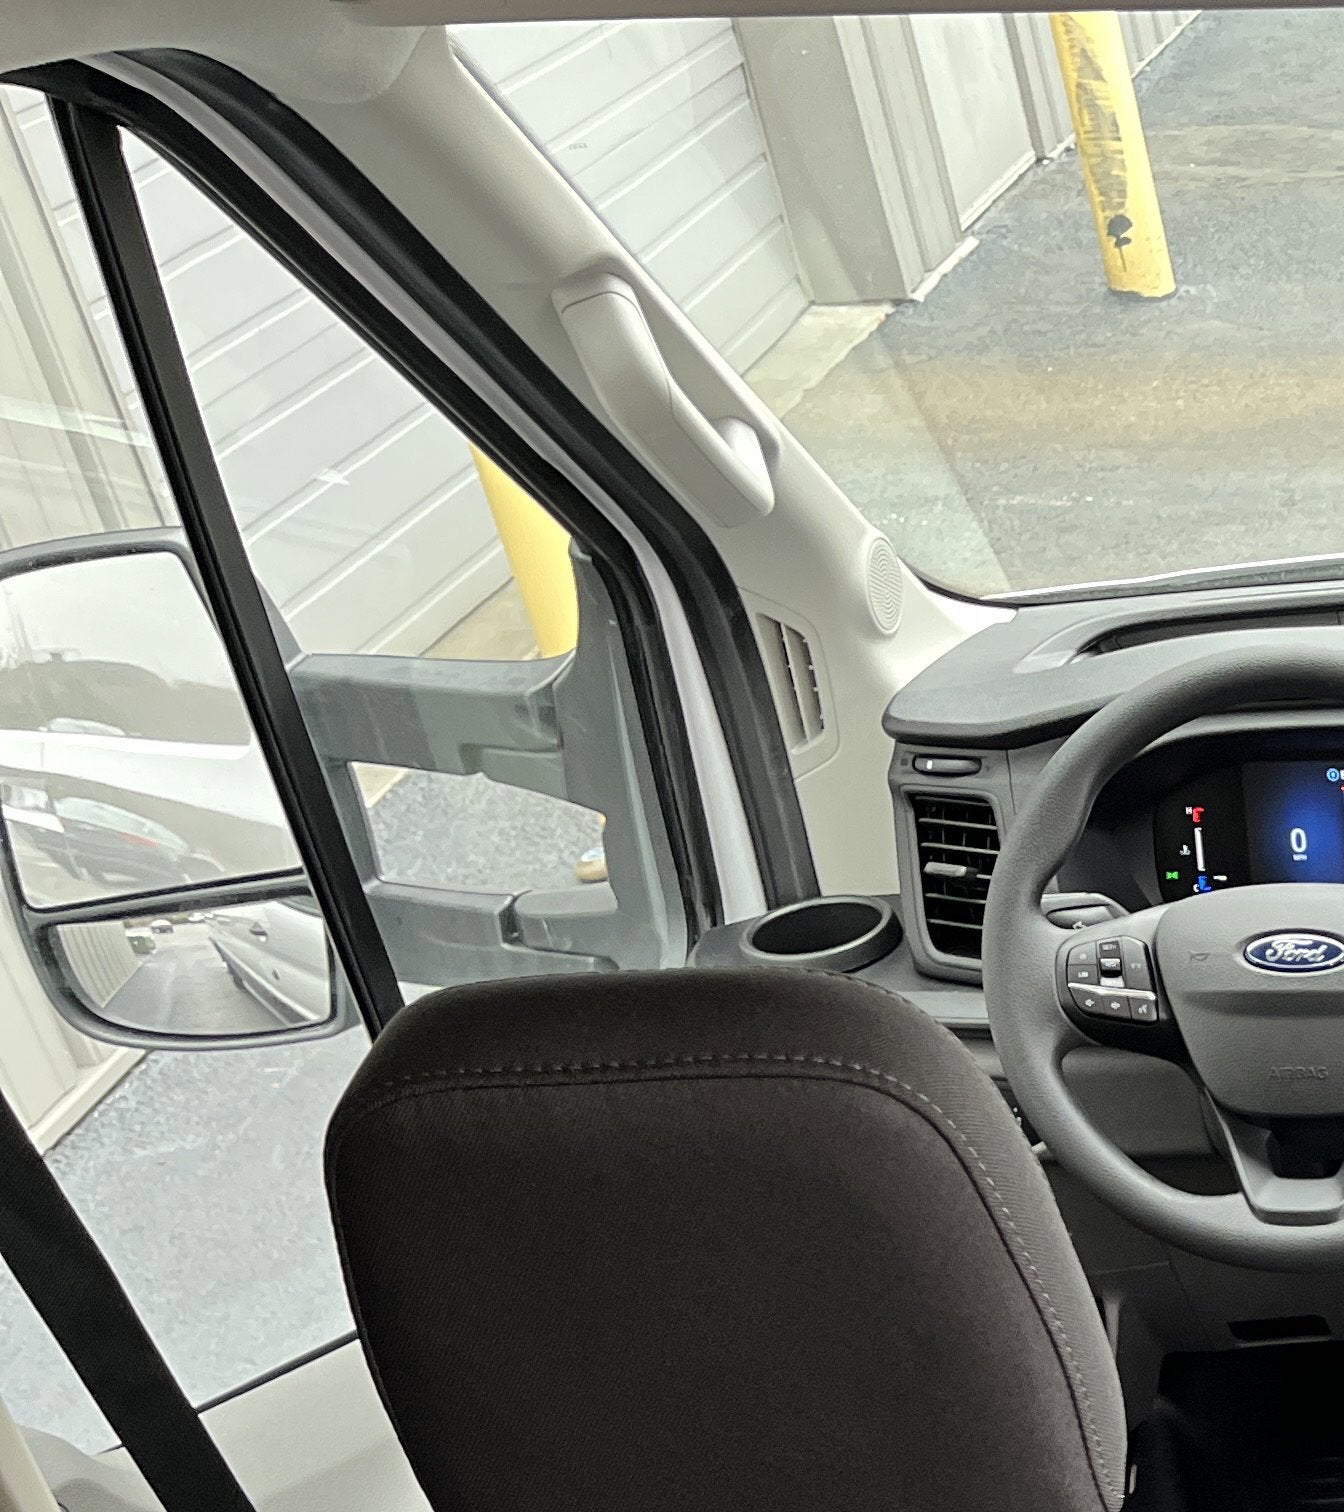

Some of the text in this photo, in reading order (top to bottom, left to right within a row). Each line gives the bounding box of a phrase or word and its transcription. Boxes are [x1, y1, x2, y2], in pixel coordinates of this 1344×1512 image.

[1290, 828, 1307, 853] 0
[1265, 939, 1328, 962] Ford
[1269, 1066, 1329, 1080] AIRBAG
